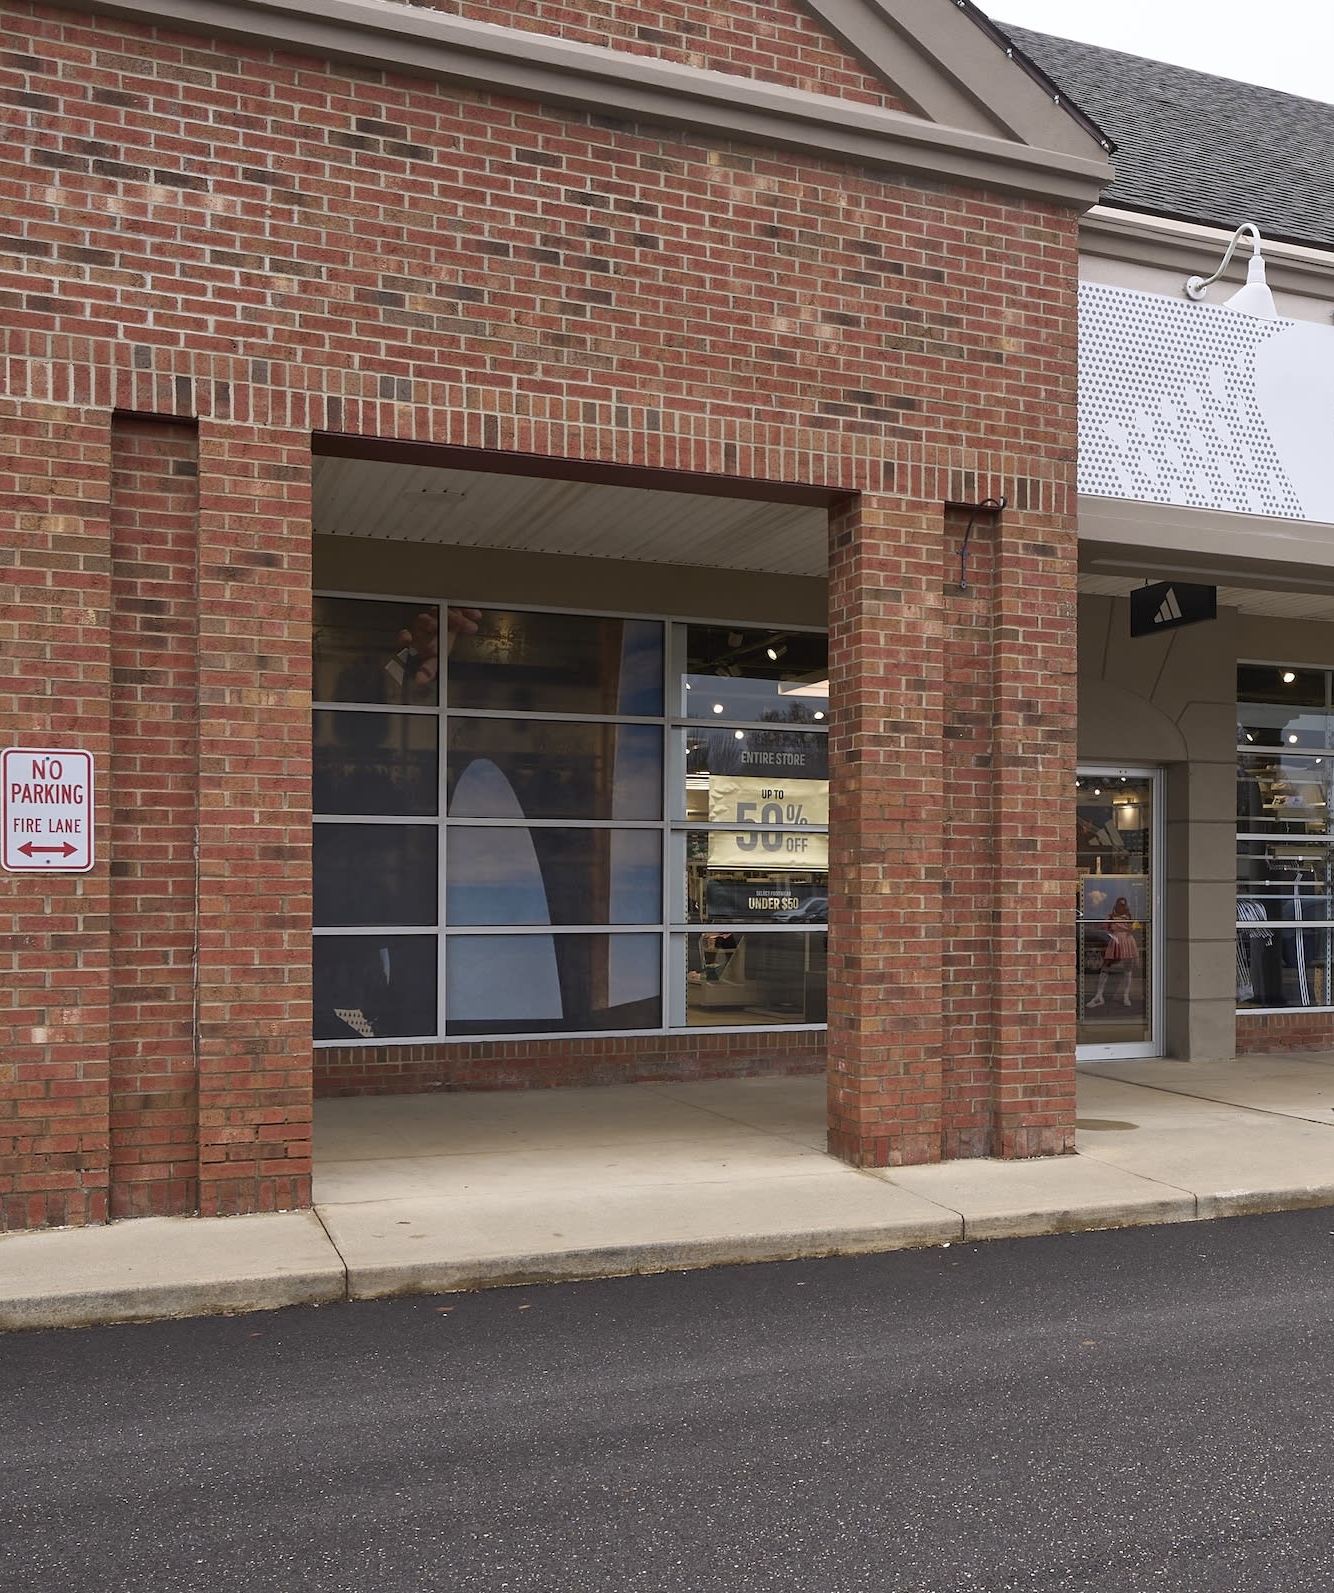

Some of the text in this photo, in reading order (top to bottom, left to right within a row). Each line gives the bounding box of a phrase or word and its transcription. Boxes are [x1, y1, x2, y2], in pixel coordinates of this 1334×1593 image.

[741, 751, 805, 766] ENTIRE STORE
[32, 760, 63, 780] NO
[11, 783, 83, 804] PARKING
[761, 789, 784, 800] UP TO
[14, 818, 82, 833] FIRE LANE
[786, 837, 808, 853] OFF
[748, 897, 799, 911] UNDER $50
